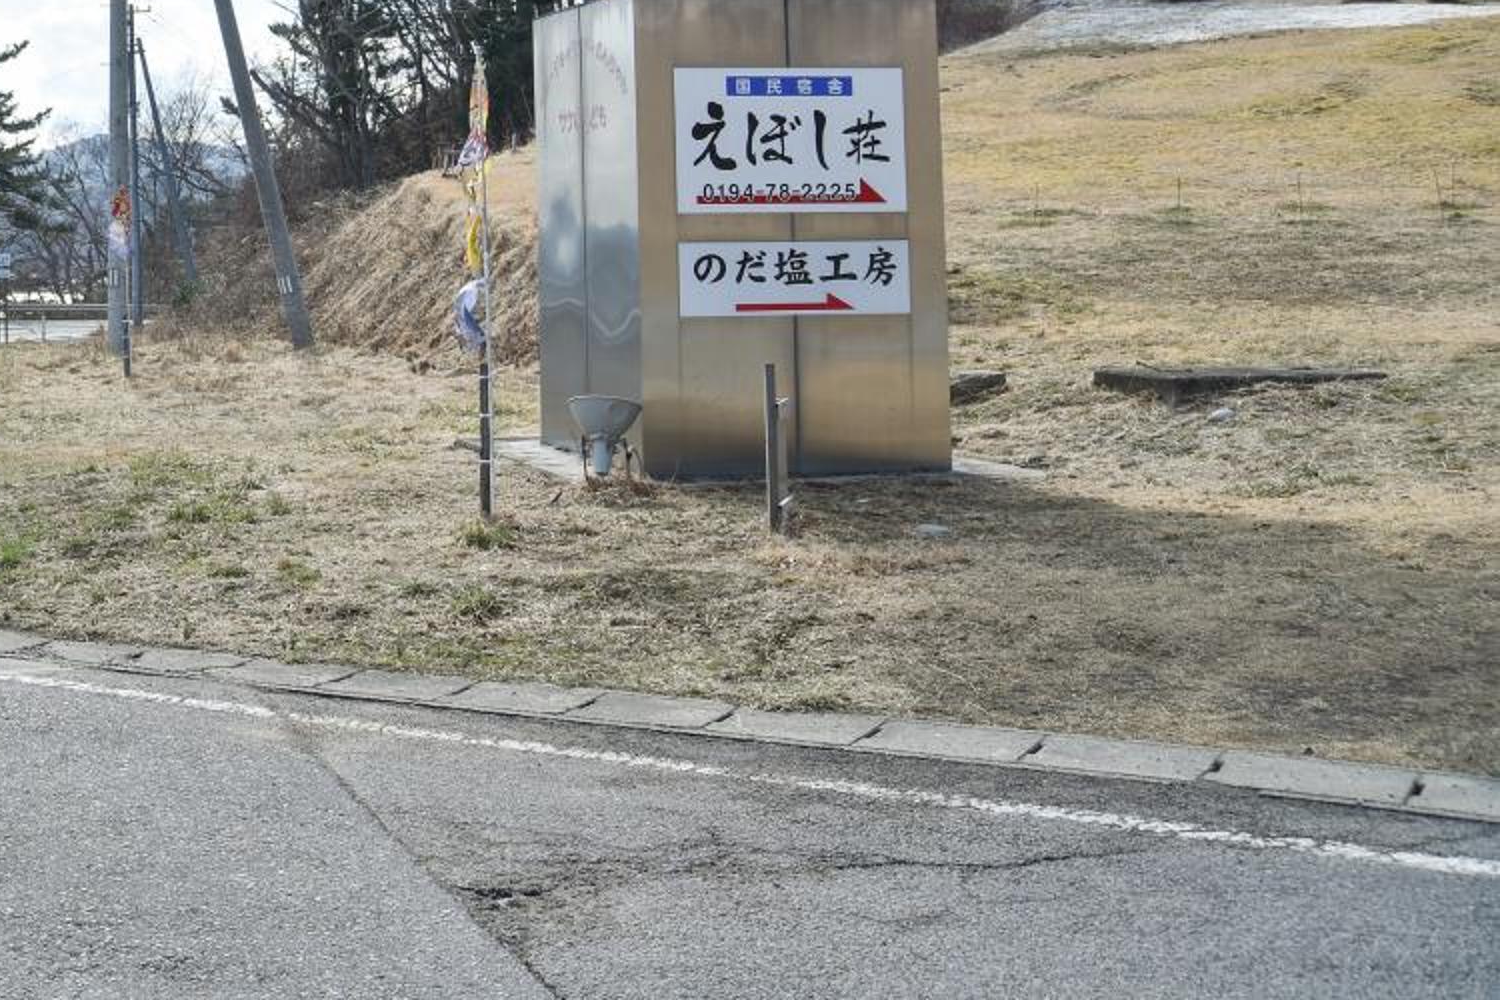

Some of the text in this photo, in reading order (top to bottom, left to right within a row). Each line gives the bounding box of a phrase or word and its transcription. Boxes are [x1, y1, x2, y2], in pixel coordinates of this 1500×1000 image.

[735, 77, 843, 96] 国民宿舎
[691, 101, 891, 171] えぼし荘
[702, 183, 857, 202] 0194-78-2225
[693, 247, 898, 287] のだ塩工房
